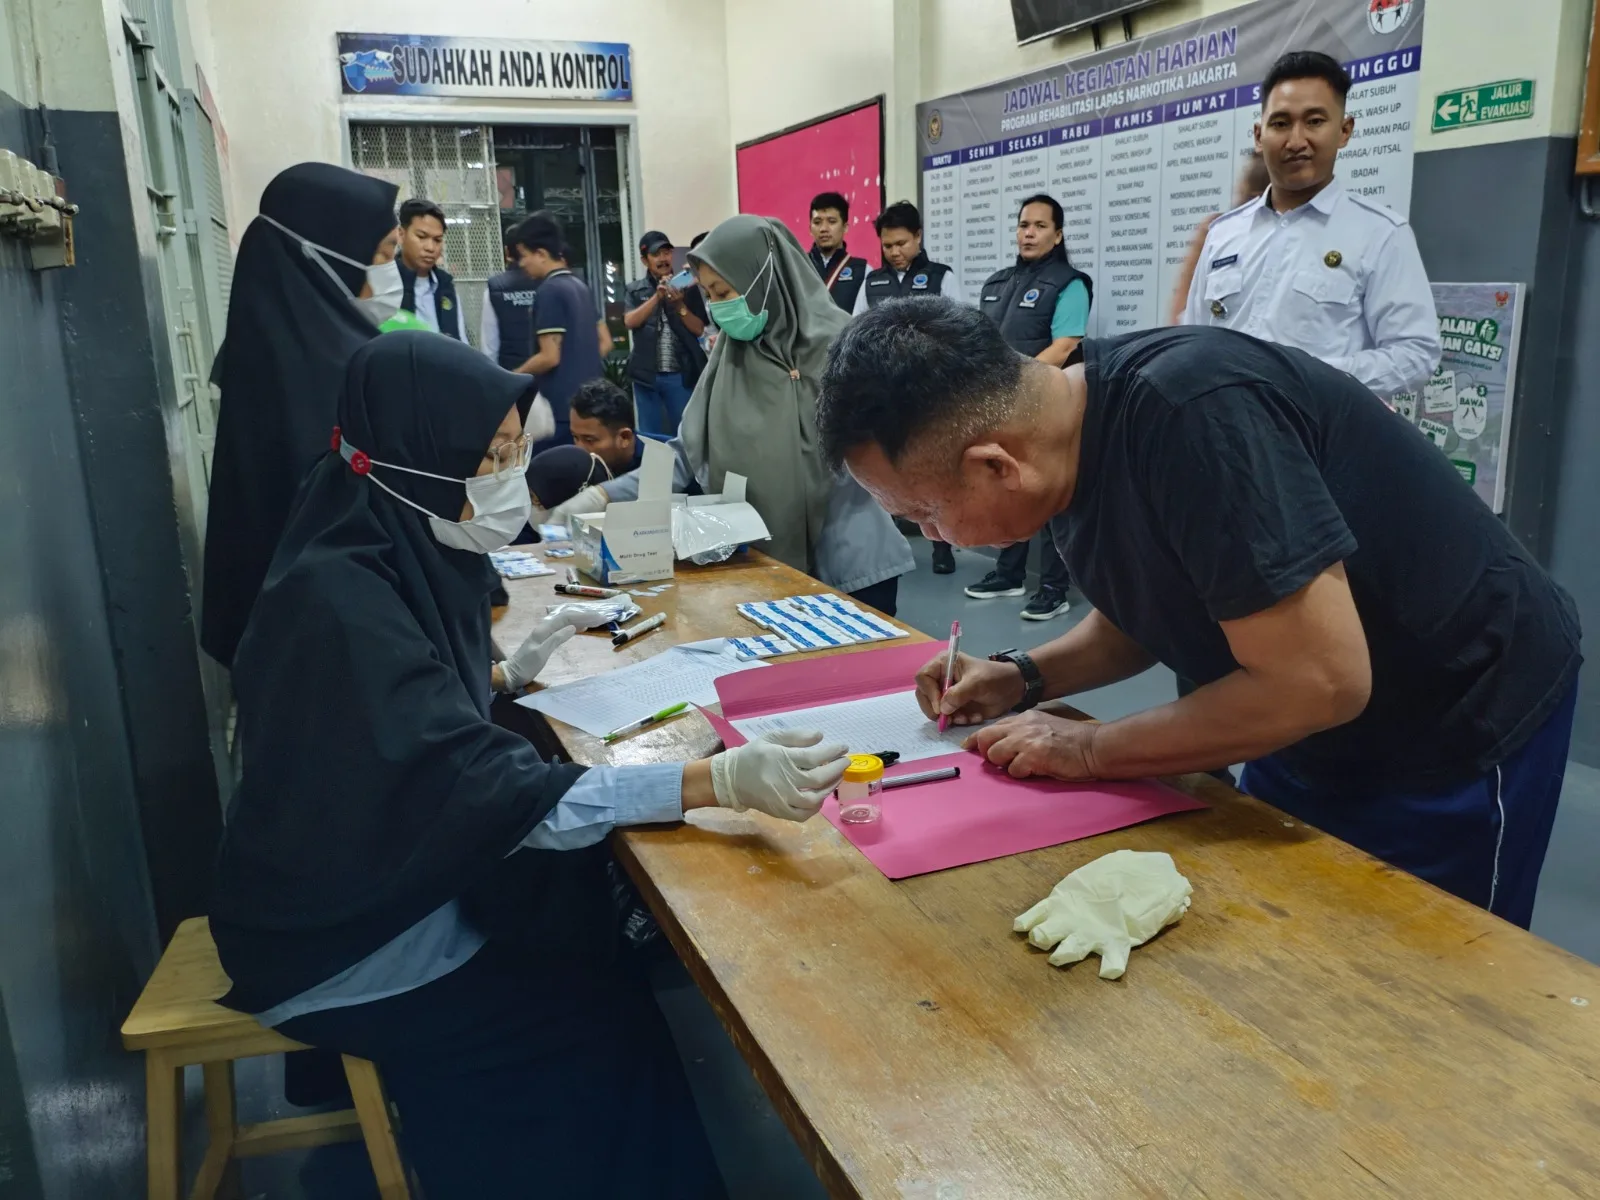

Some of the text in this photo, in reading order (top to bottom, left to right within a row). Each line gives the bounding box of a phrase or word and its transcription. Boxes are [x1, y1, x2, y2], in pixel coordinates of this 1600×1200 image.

[392, 44, 629, 90] SUDAHKAH ANDA KONTROL
[1003, 25, 1237, 114] JADWAL KEGIATAN HARIAN
[1343, 52, 1413, 79] INGGU
[1001, 62, 1238, 132] PROGRAM REHABILITASI LAPAS NARKOTIKA JAKARTA
[1346, 84, 1397, 101] HALAT SUBUH
[1490, 83, 1522, 100] JALUR
[1175, 93, 1227, 117] JUM'AT
[1366, 103, 1389, 117] WASH
[1390, 102, 1402, 113] UP
[1480, 100, 1530, 119] EVAKUASI
[1114, 110, 1153, 129] KAMIS
[1062, 124, 1090, 140] RABU
[1362, 124, 1391, 137] MAKAN
[1392, 121, 1411, 133] PAGI
[1008, 134, 1044, 152] SELASA
[1372, 143, 1402, 156] FUTSAL
[969, 145, 994, 160] SENIN
[1351, 166, 1379, 179] IBADAH
[1363, 185, 1385, 197] BAKTI
[503, 290, 537, 301] NARCOT
[1437, 317, 1477, 336] ALAH
[1440, 336, 1462, 352] AN
[1459, 397, 1484, 408] BAWA
